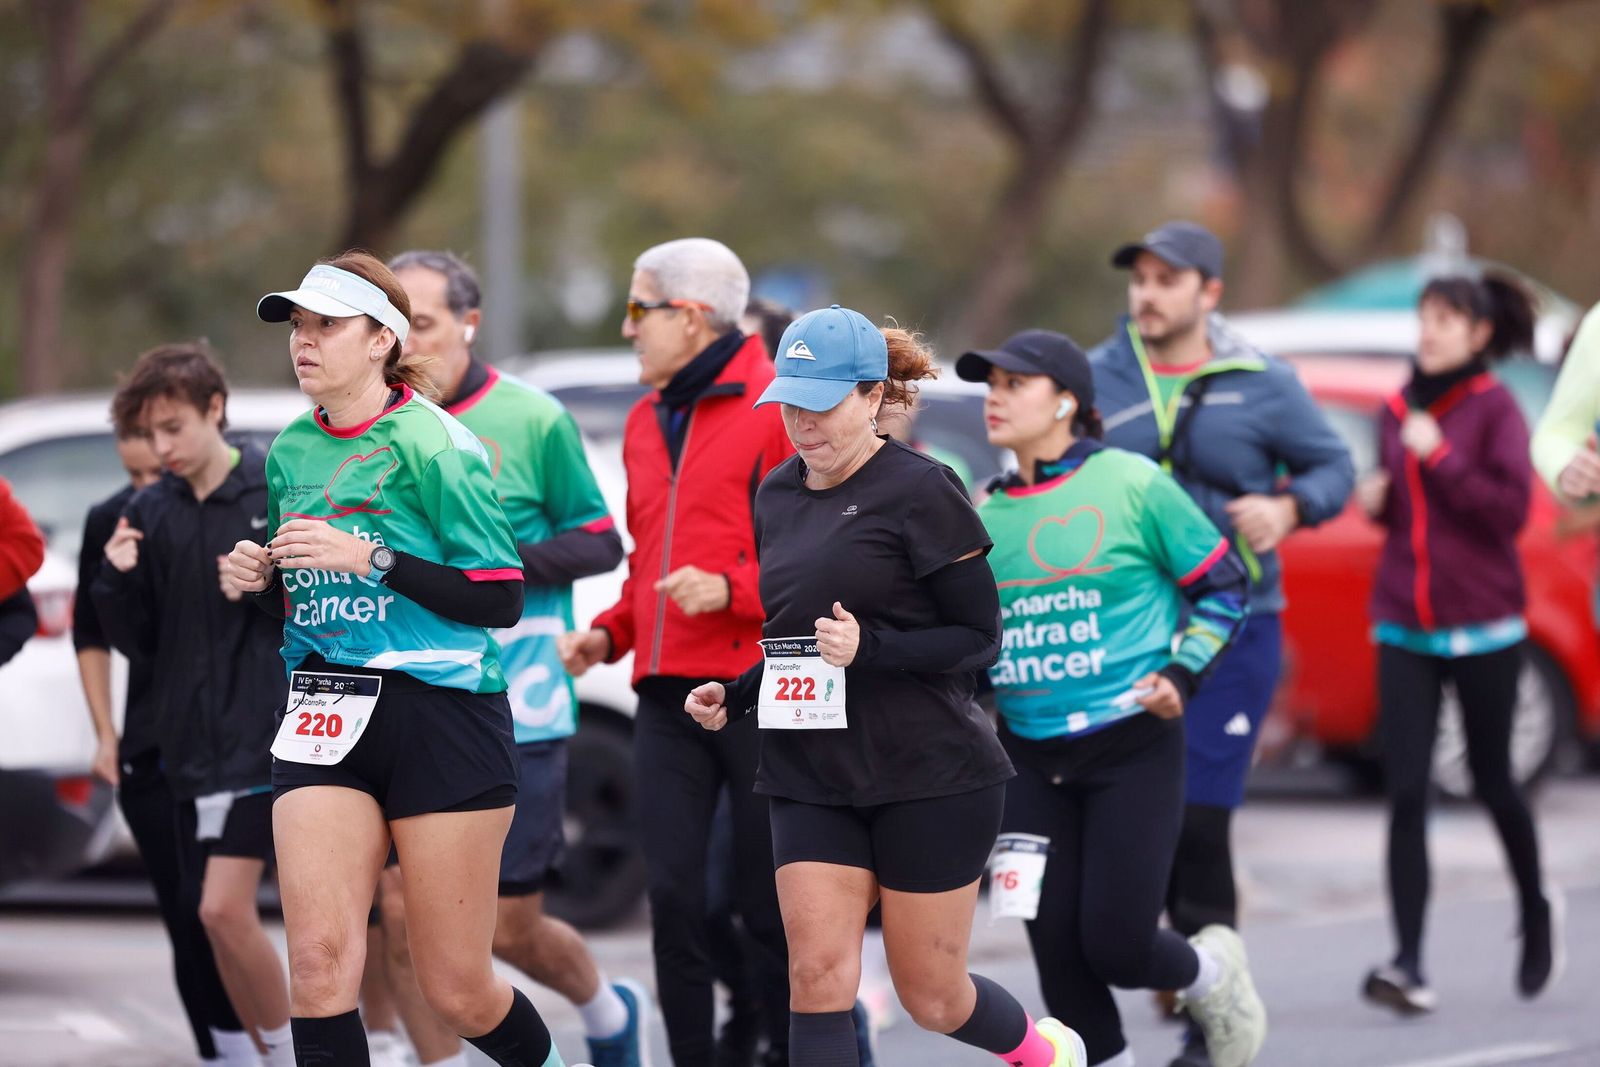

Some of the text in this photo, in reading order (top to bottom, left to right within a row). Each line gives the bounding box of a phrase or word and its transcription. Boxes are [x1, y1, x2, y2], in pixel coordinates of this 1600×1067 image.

[293, 590, 395, 627] cáncer
[1001, 611, 1102, 649] ntra el
[782, 642, 802, 650] Marcha
[313, 677, 332, 686] archa
[334, 682, 355, 690] 20
[775, 677, 816, 701] 222
[296, 712, 343, 738] 220
